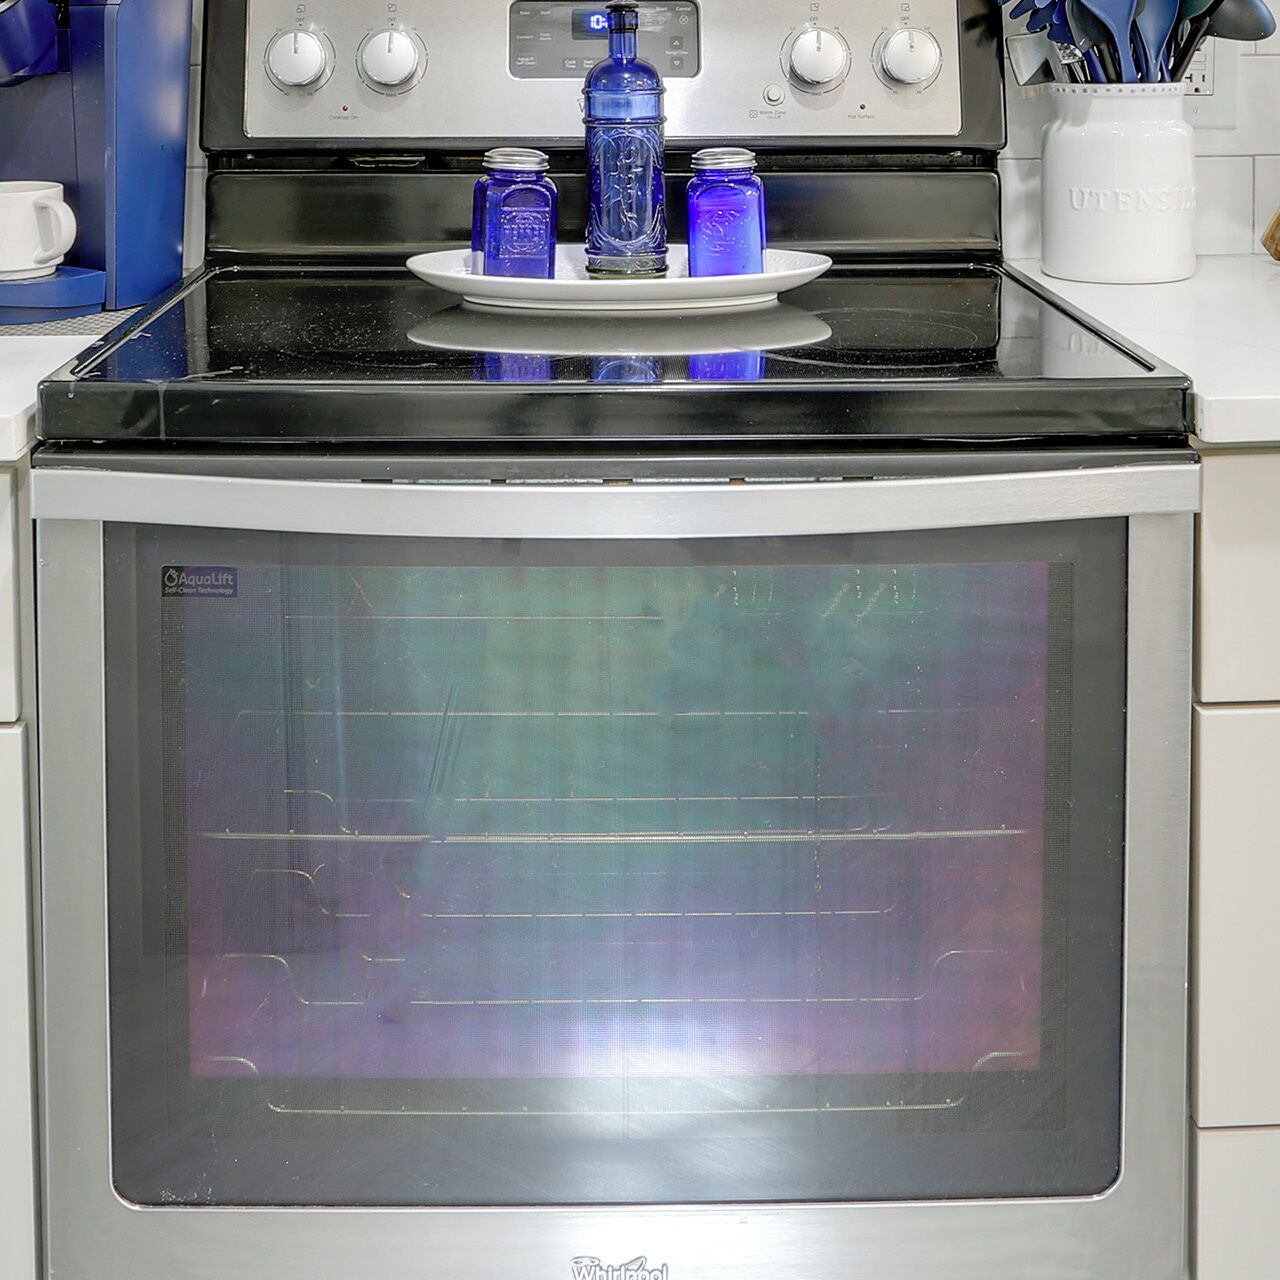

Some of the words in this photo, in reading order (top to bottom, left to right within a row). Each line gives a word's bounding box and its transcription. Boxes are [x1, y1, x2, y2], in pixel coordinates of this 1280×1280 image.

[590, 14, 608, 29] 10:
[178, 572, 234, 586] AquaLift
[164, 586, 197, 594] Self-Clean
[198, 586, 234, 595] Technology
